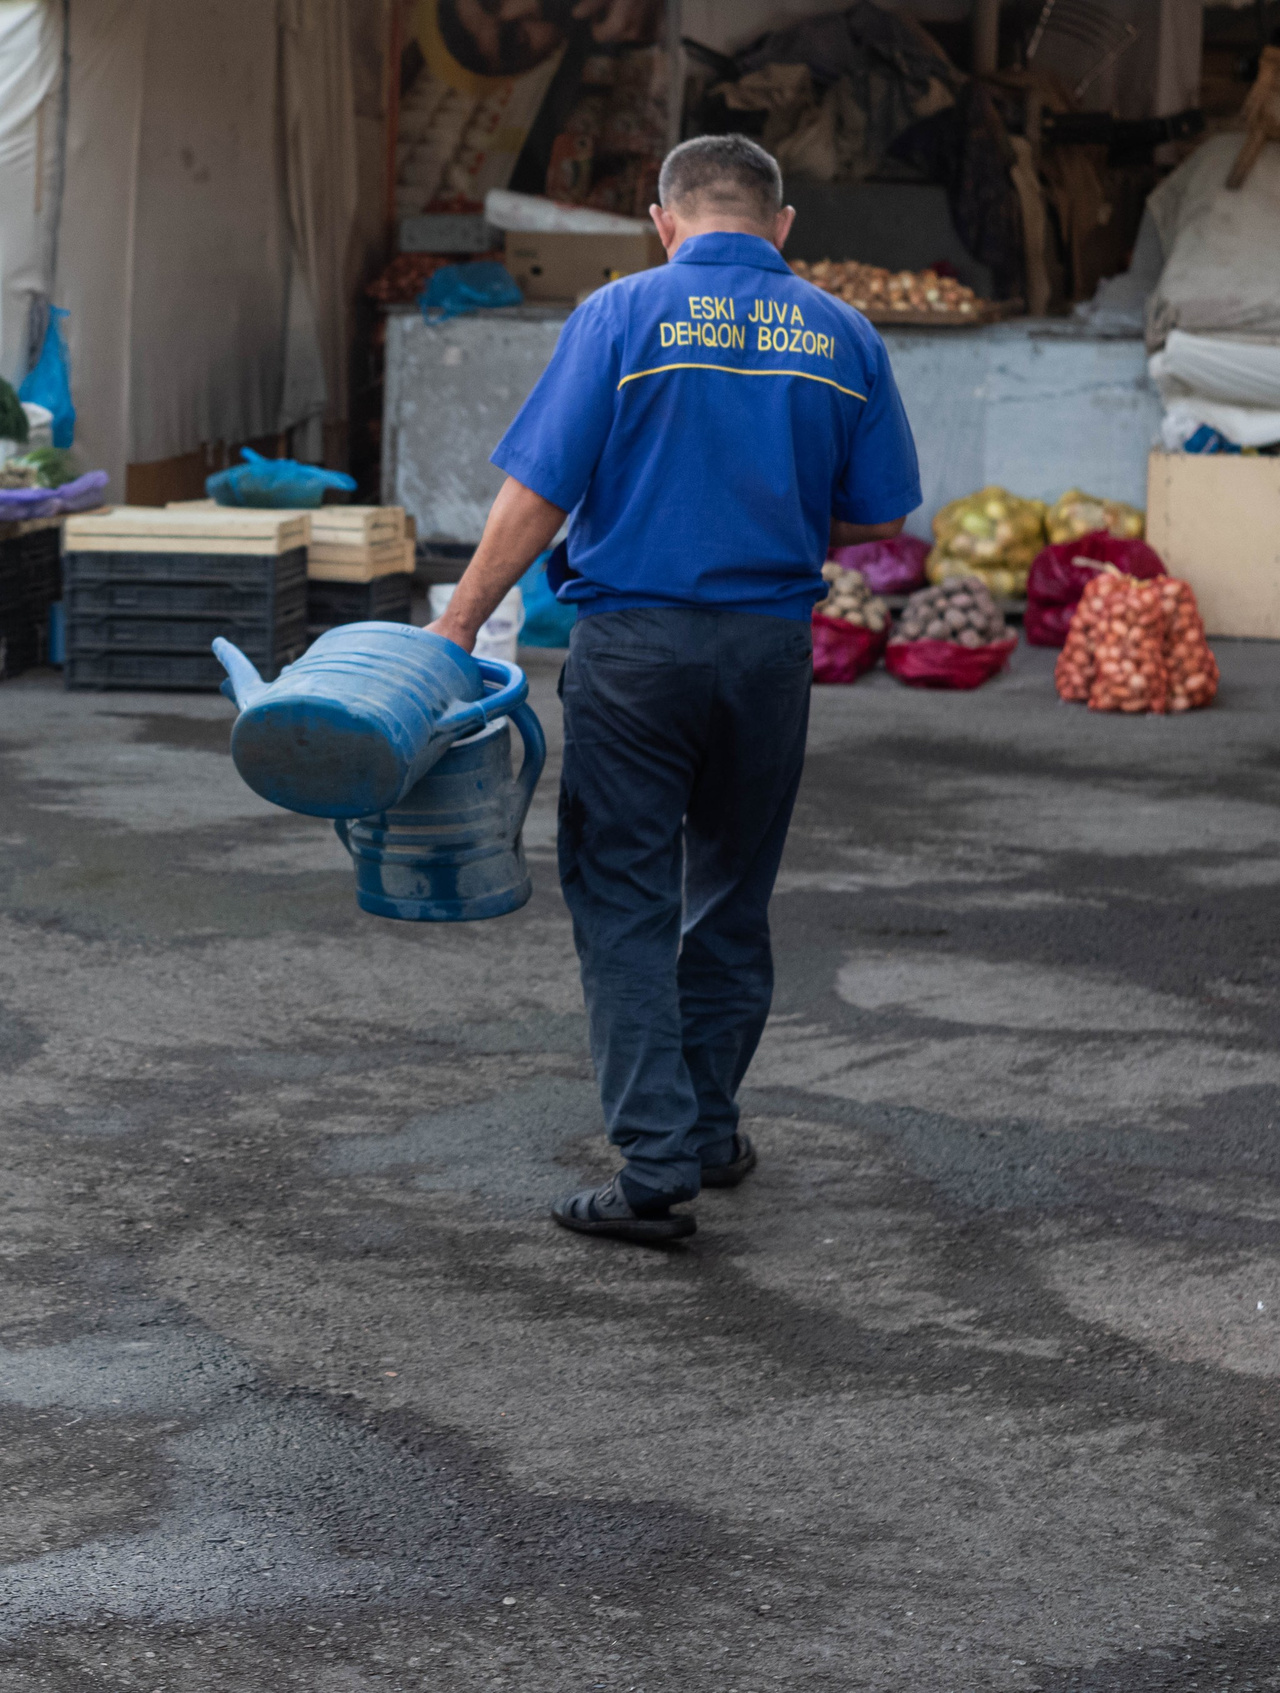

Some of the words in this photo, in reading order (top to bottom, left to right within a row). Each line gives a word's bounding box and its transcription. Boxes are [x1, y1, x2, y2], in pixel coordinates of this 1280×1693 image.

[688, 296, 735, 321] ESKI
[747, 298, 805, 327] JUVA
[659, 321, 746, 350] DEHQON
[757, 326, 835, 360] BOZORI
